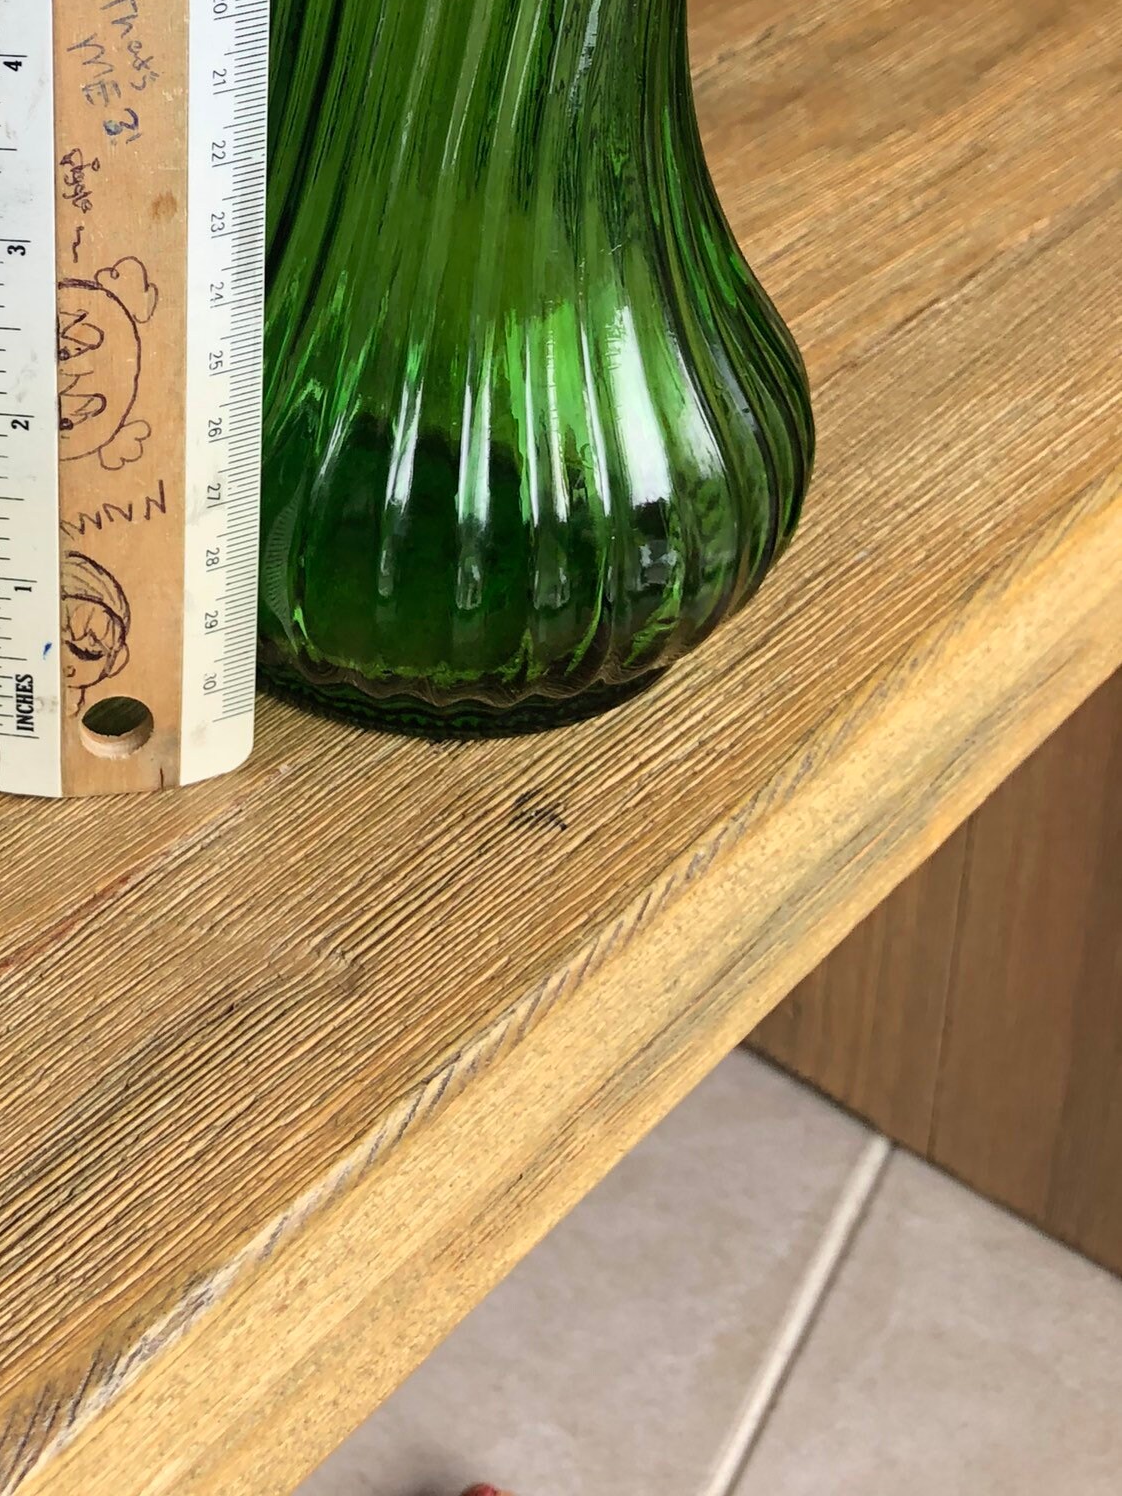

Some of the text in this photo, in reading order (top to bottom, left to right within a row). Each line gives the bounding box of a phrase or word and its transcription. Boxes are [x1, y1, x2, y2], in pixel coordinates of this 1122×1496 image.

[3, 60, 22, 72] 4
[212, 69, 227, 87] 21
[211, 142, 226, 162] 22
[210, 212, 225, 232] 23
[7, 244, 26, 256] 3
[209, 281, 225, 301] 24
[208, 351, 223, 370] 25
[11, 418, 29, 431] 2
[207, 418, 222, 438] 26
[206, 483, 221, 502] 27
[205, 548, 220, 567] 28
[204, 611, 218, 630] 29
[16, 673, 34, 733] INCHES
